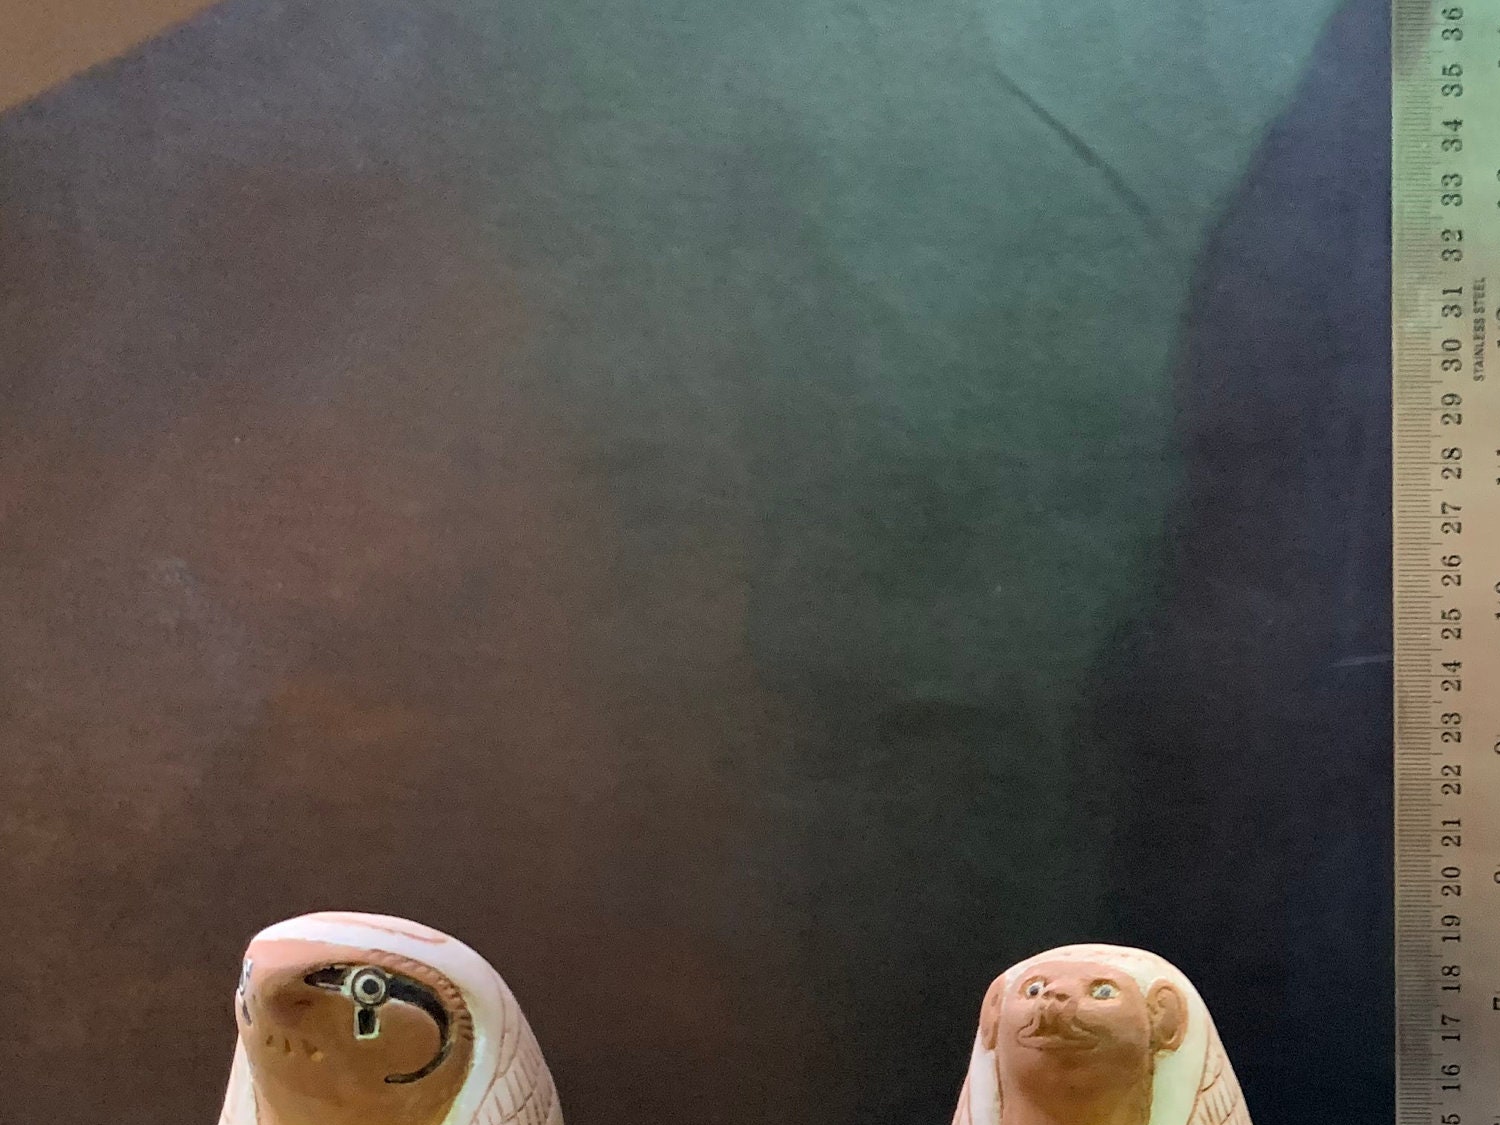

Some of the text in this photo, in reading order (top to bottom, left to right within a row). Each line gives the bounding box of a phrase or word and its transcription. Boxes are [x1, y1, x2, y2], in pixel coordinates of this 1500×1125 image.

[1440, 6, 1464, 42] 36
[1440, 63, 1464, 98] 35
[1440, 119, 1464, 152] 34
[1440, 173, 1464, 207] 33
[1440, 228, 1464, 262] 32
[1440, 285, 1464, 319] 31
[1472, 276, 1487, 382] STAINLESS STEEL
[1440, 337, 1463, 373] 30
[1440, 392, 1463, 426] 29
[1440, 446, 1463, 480] 28
[1440, 501, 1463, 535] 27
[1440, 554, 1462, 587] 26
[1440, 607, 1463, 640] 25
[1440, 659, 1463, 692] 24
[1440, 711, 1462, 744] 23
[1440, 764, 1462, 796] 22
[1440, 818, 1462, 848] 21
[1440, 865, 1461, 897] 20
[1440, 914, 1462, 943] 19
[1440, 964, 1461, 994] 18
[1440, 1014, 1461, 1043] 17
[1440, 1064, 1461, 1092] 16
